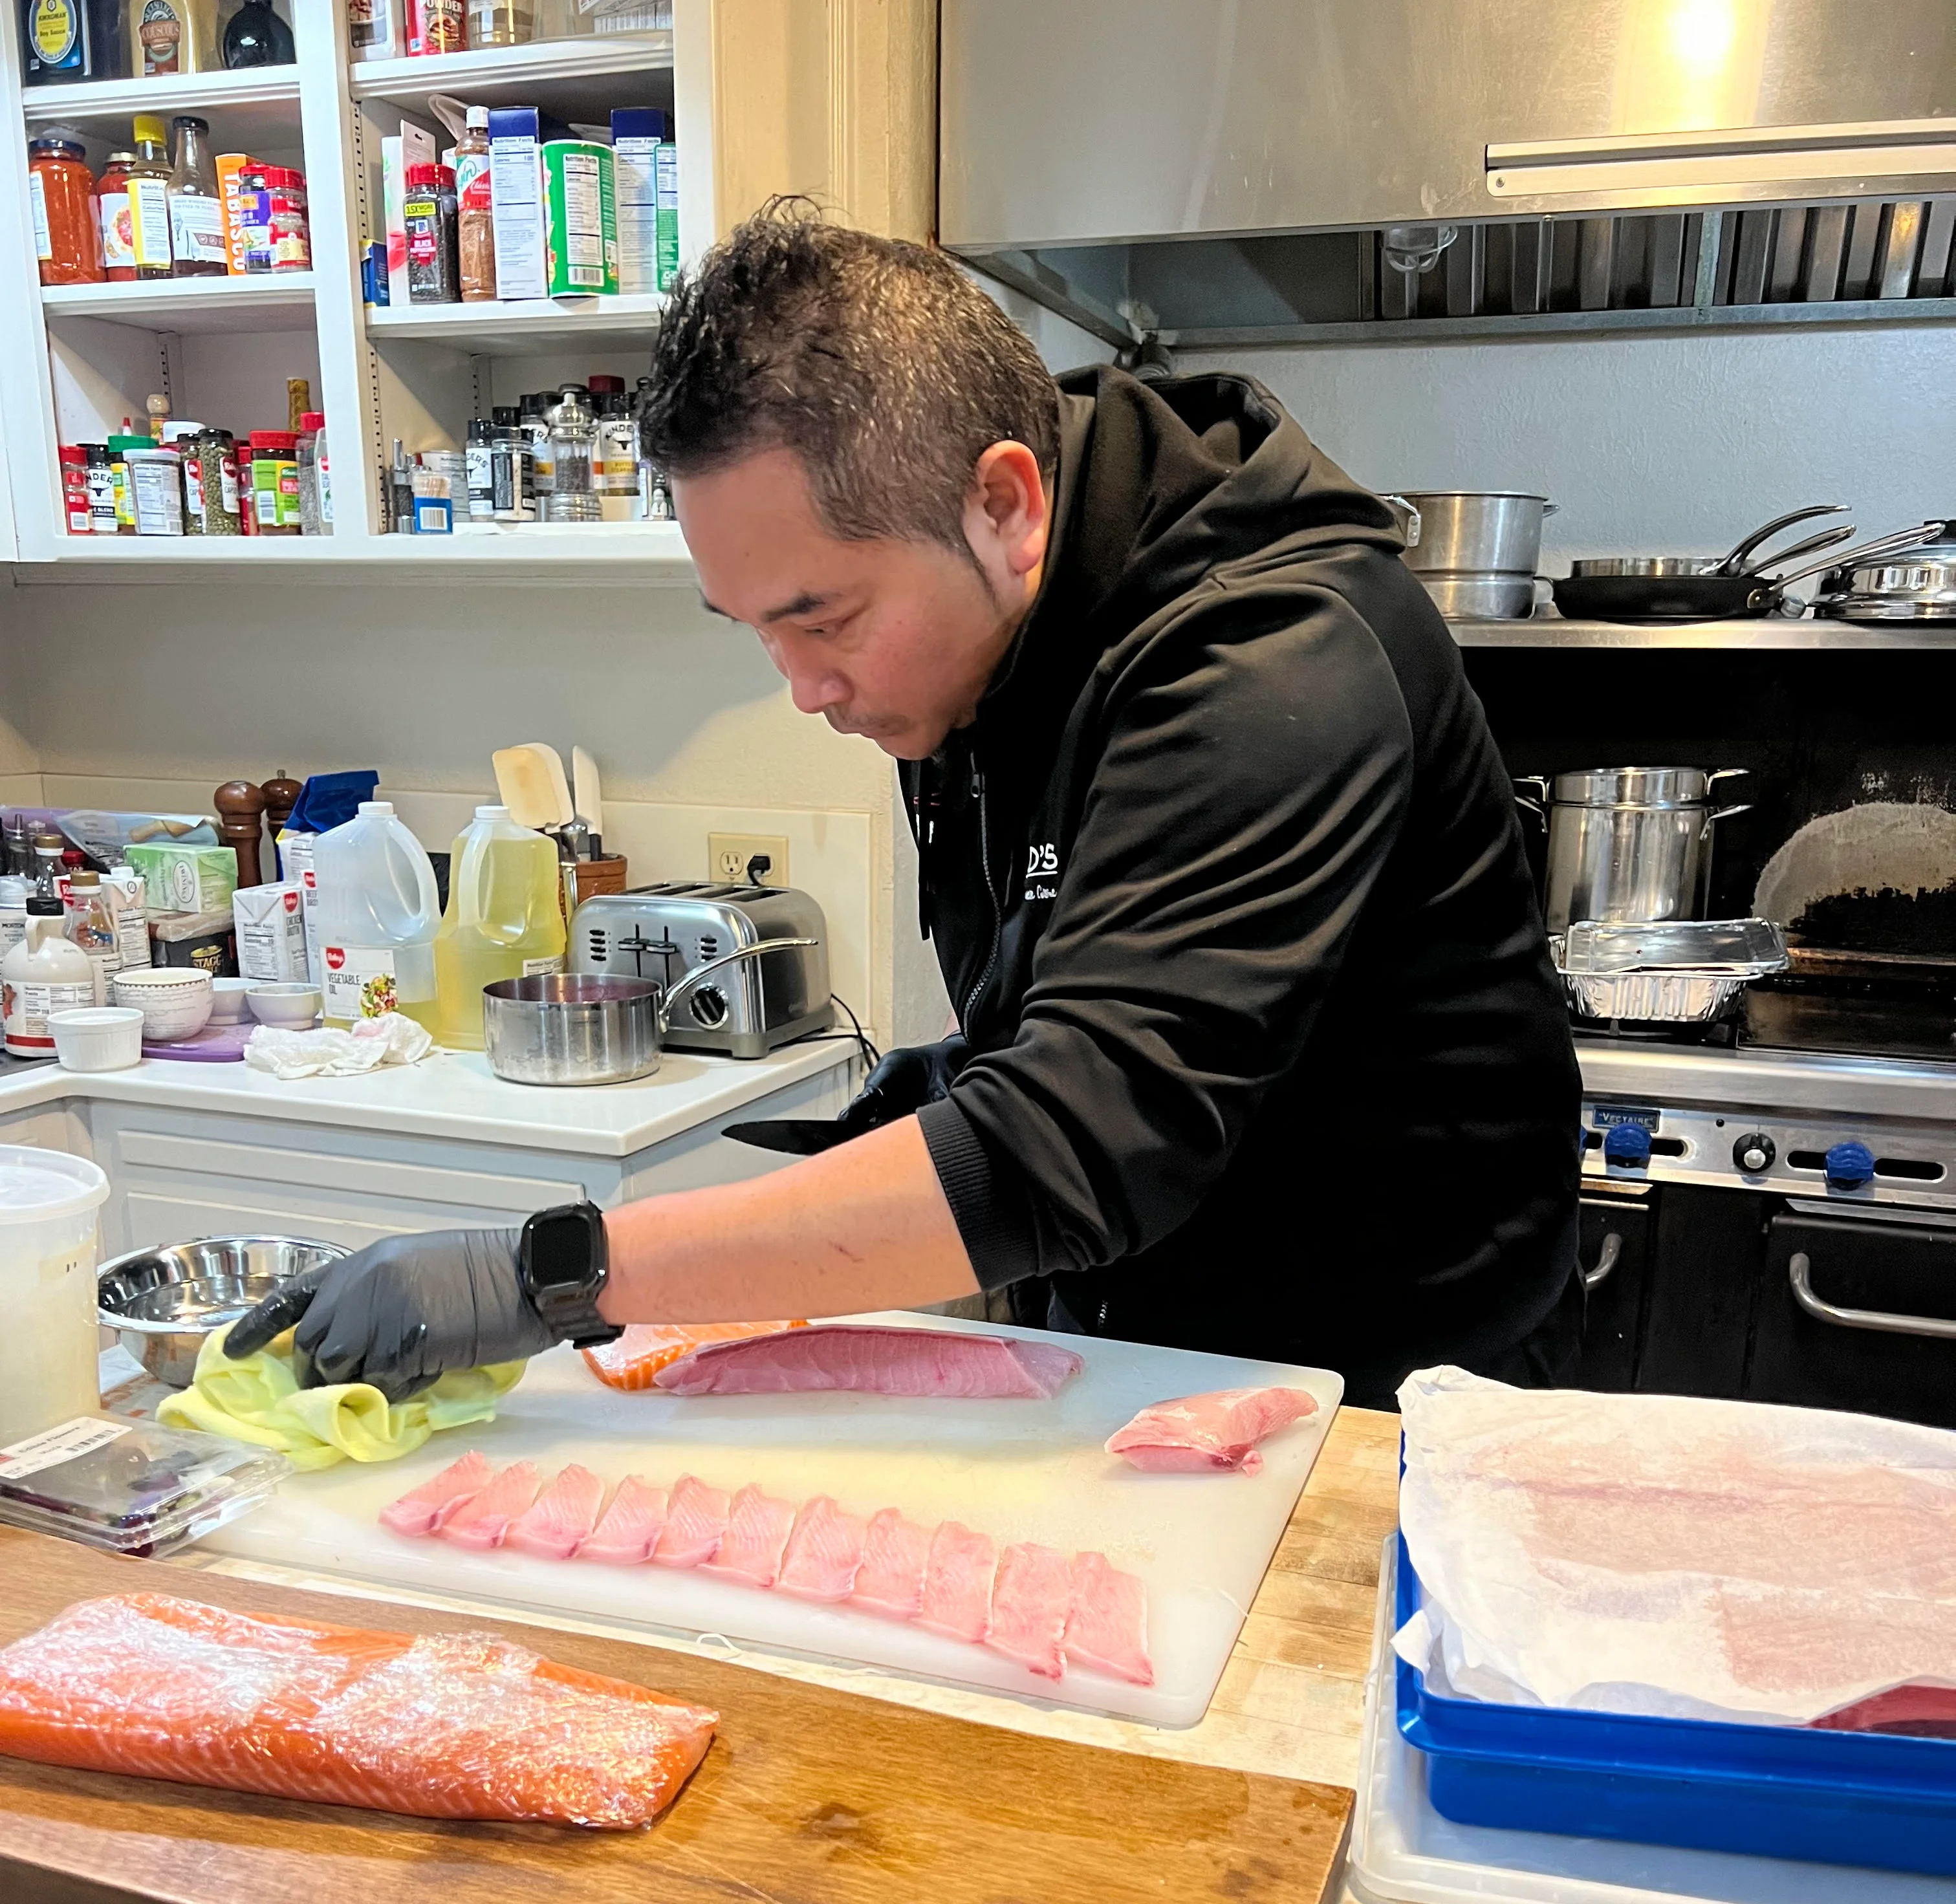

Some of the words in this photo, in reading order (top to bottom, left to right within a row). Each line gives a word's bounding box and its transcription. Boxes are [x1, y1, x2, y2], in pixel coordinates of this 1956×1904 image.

[224, 173, 245, 270] TABASCO
[1027, 843, 1058, 873] D'S
[327, 973, 360, 985] VEGETABLE
